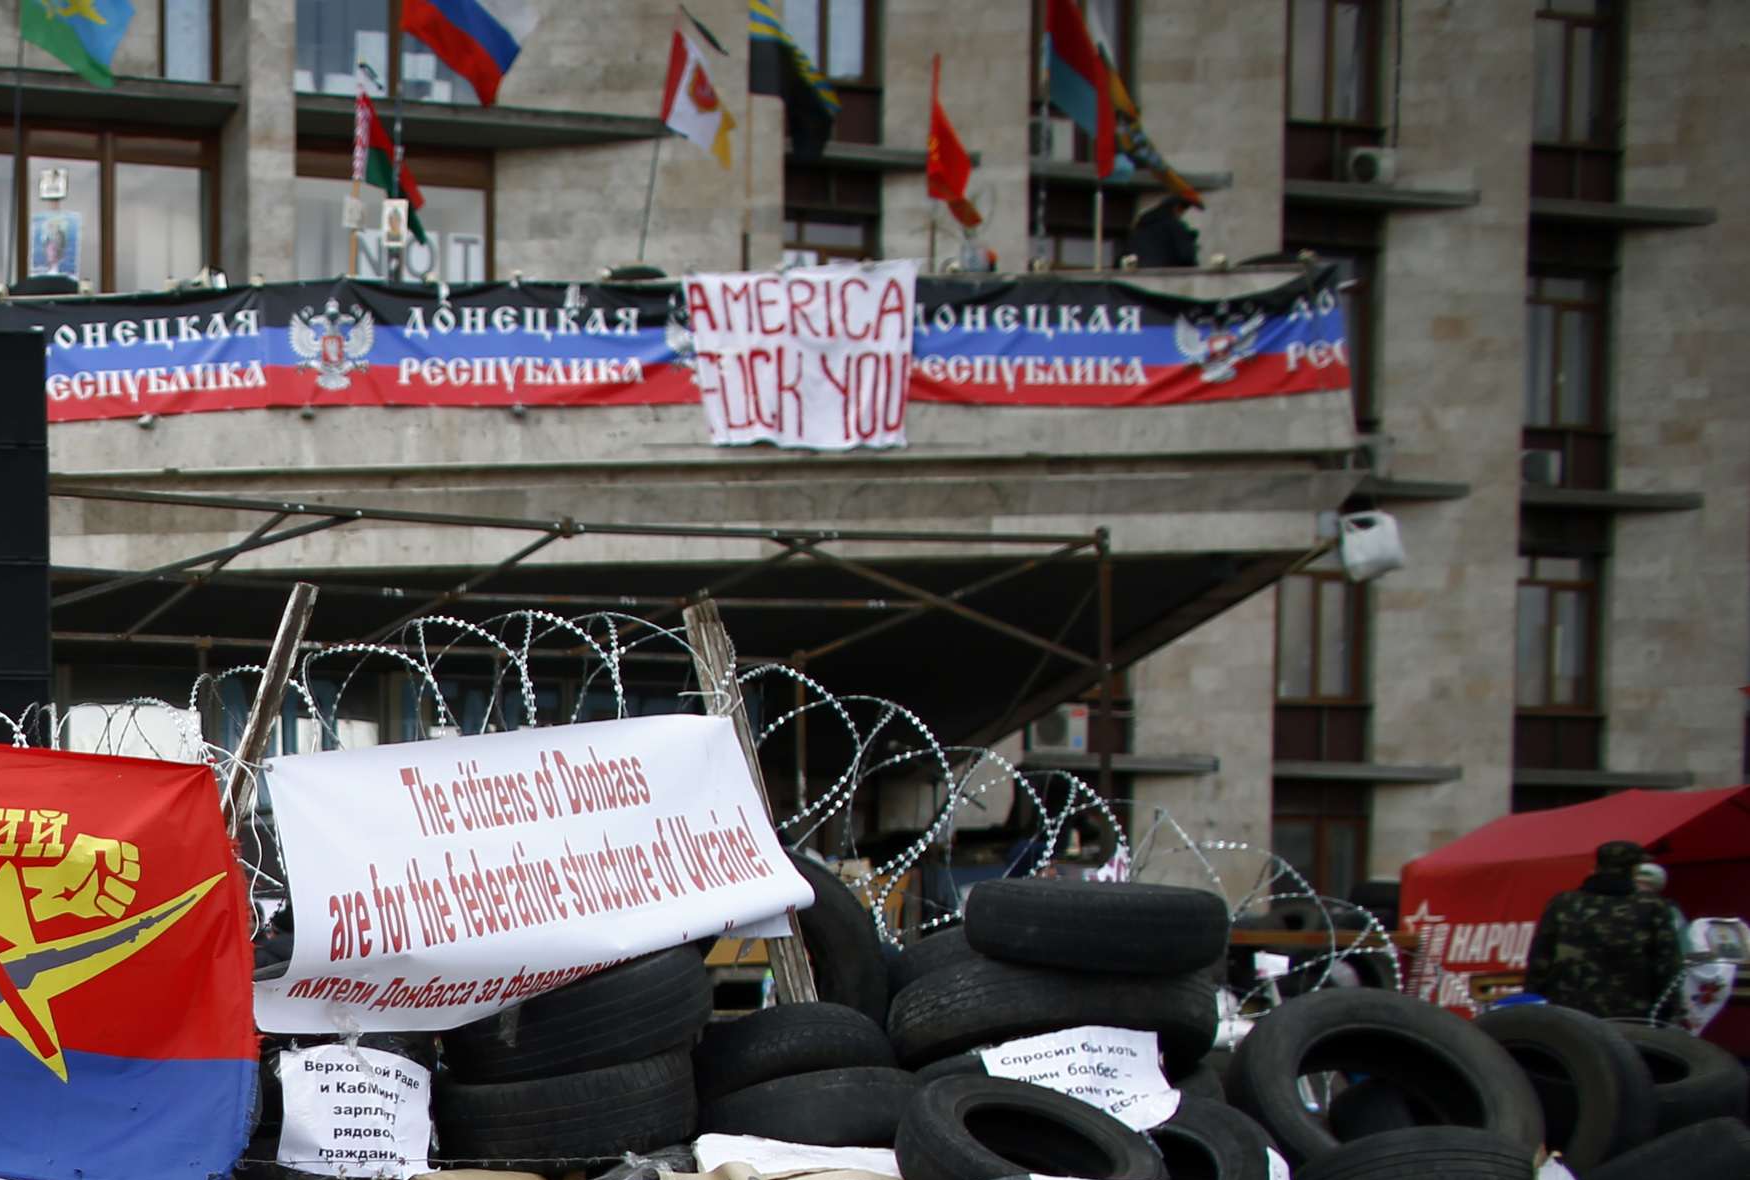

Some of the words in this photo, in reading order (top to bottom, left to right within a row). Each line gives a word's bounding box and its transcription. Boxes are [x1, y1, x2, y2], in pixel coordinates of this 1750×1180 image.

[403, 306, 640, 343] ДОНЕЦКАЯ
[688, 278, 905, 341] AMERICA
[46, 309, 260, 356] ОНЕЦКАЯ
[46, 360, 266, 402] ЕСПУБЛИКА
[398, 356, 644, 393] РЕСПУБЛИКА
[821, 352, 908, 440] YOU
[400, 767, 454, 838] The
[457, 759, 539, 832] citizens
[535, 750, 555, 820] of
[553, 744, 651, 816] Donbass
[328, 889, 372, 962] are
[369, 863, 411, 954] for
[406, 857, 458, 945] the
[456, 843, 569, 938] federative
[563, 831, 663, 918] structure
[655, 819, 684, 898] of
[680, 804, 776, 895] Ukraine!
[369, 976, 478, 1012] Донбасса
[474, 983, 502, 1004] за
[1001, 1046, 1076, 1065] Спросил
[1080, 1040, 1103, 1054] бы
[1107, 1044, 1138, 1057] хоть
[1067, 1062, 1118, 1080] балбес
[320, 1084, 330, 1093] и
[395, 1069, 420, 1090] Раде
